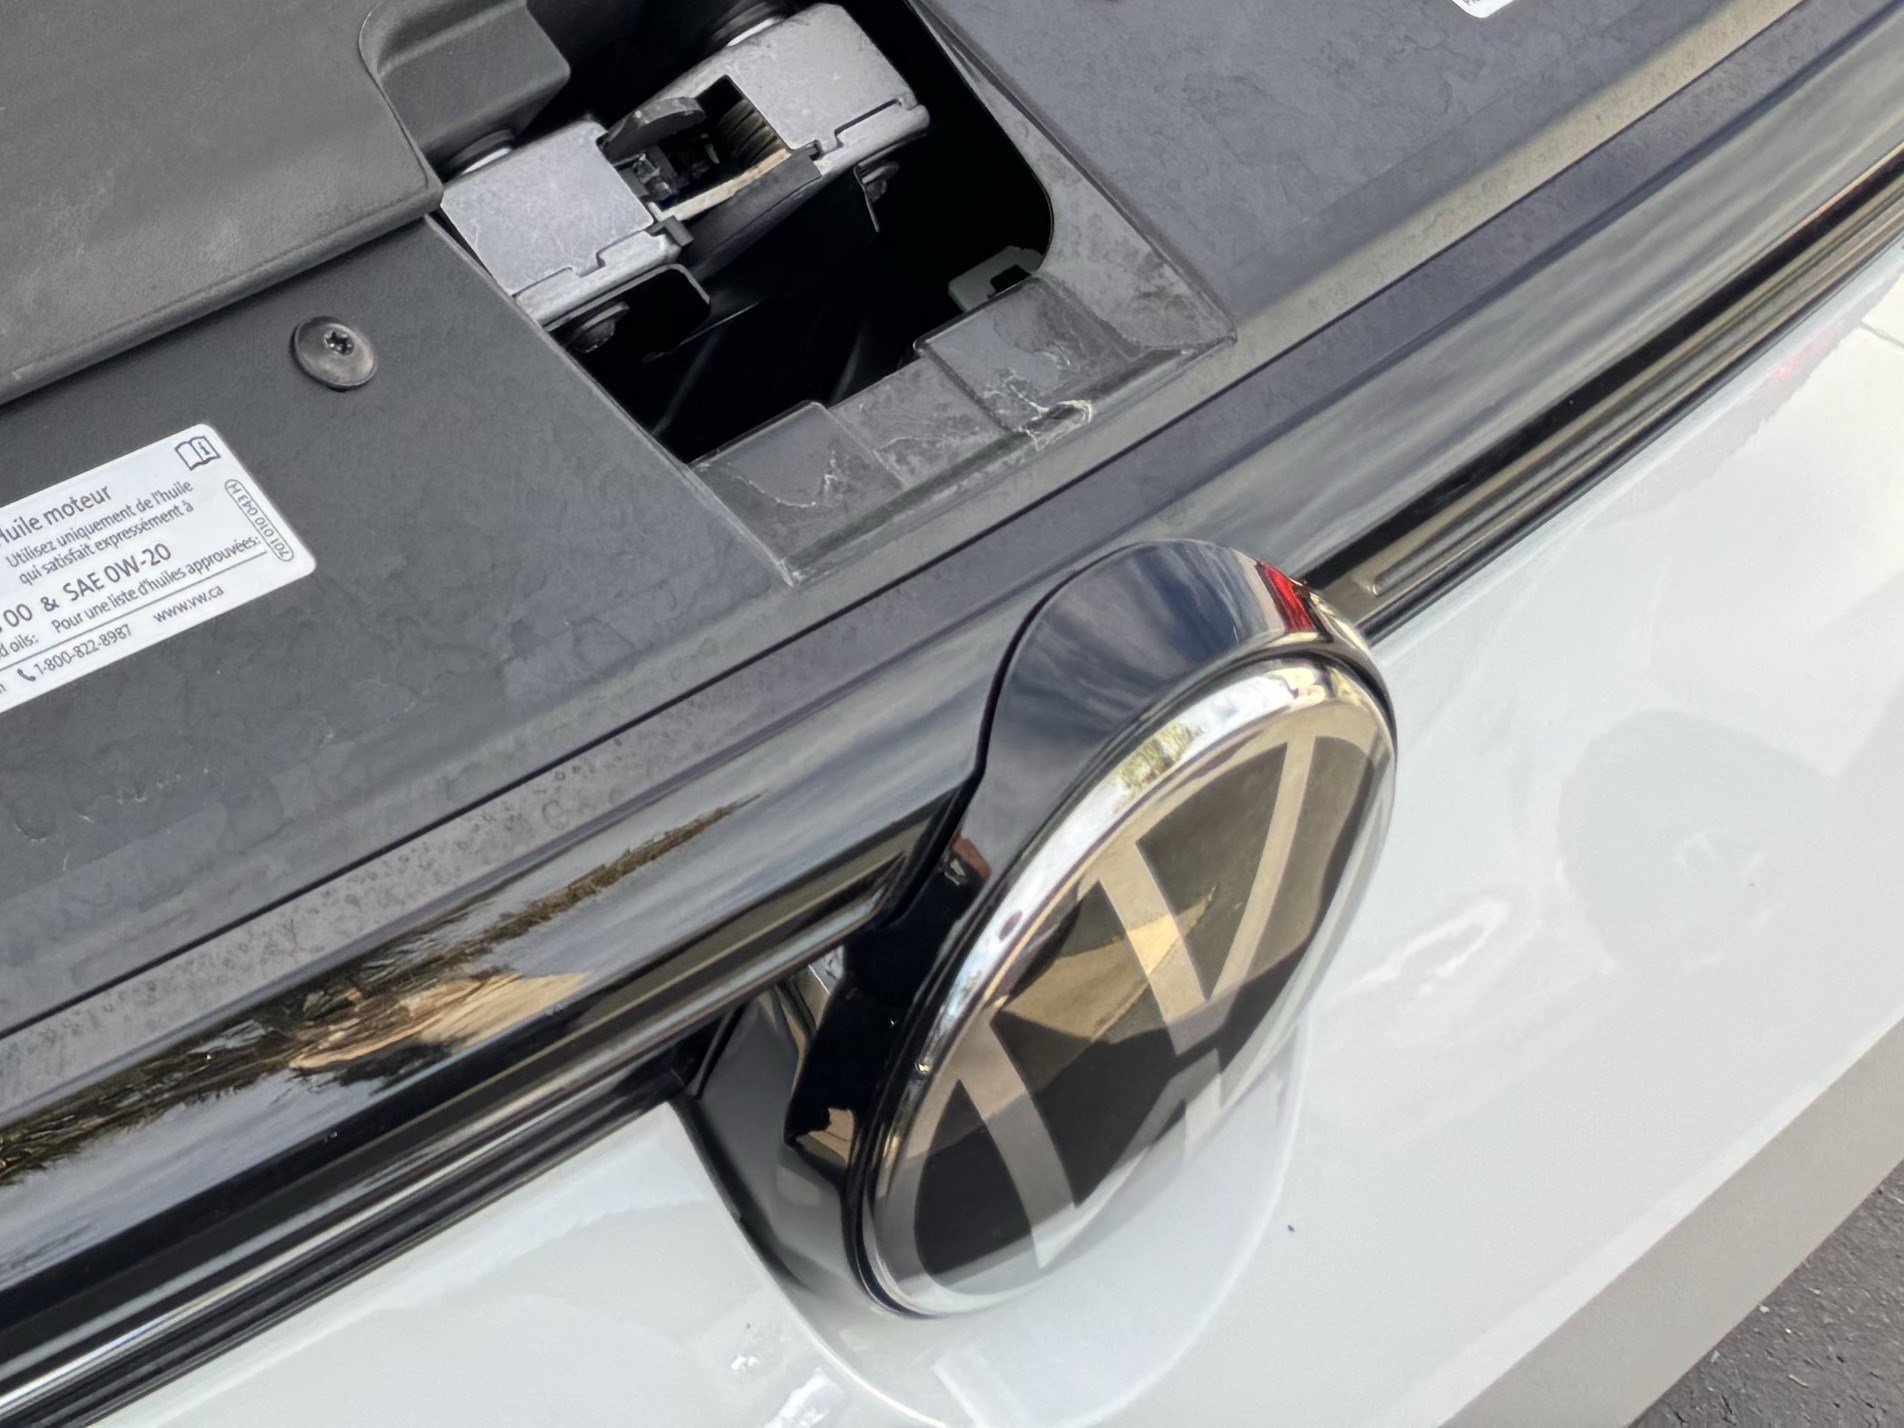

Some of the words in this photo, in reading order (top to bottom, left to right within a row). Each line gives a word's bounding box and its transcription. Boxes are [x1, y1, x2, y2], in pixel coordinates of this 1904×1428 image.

[39, 483, 114, 525] moteur
[228, 482, 241, 494] H
[237, 492, 259, 518] 043
[4, 537, 58, 568] Utilisez
[54, 504, 138, 549] uniquement
[132, 496, 155, 513] de
[150, 479, 194, 505] l'huile
[16, 565, 45, 586] qui
[38, 542, 95, 574] satisfait
[180, 499, 195, 512] à
[254, 514, 275, 538] 010
[0, 602, 35, 628] 00
[38, 593, 60, 612] &
[61, 572, 105, 601] SAE
[101, 541, 174, 583] 0W-20
[51, 610, 85, 633] Pour
[82, 601, 110, 619] une
[106, 586, 139, 608] liste
[134, 564, 187, 596] d'huiles
[151, 583, 225, 623] www.vw.ca
[6, 630, 40, 653] oils:
[32, 622, 134, 676] 1-800-822-8987
